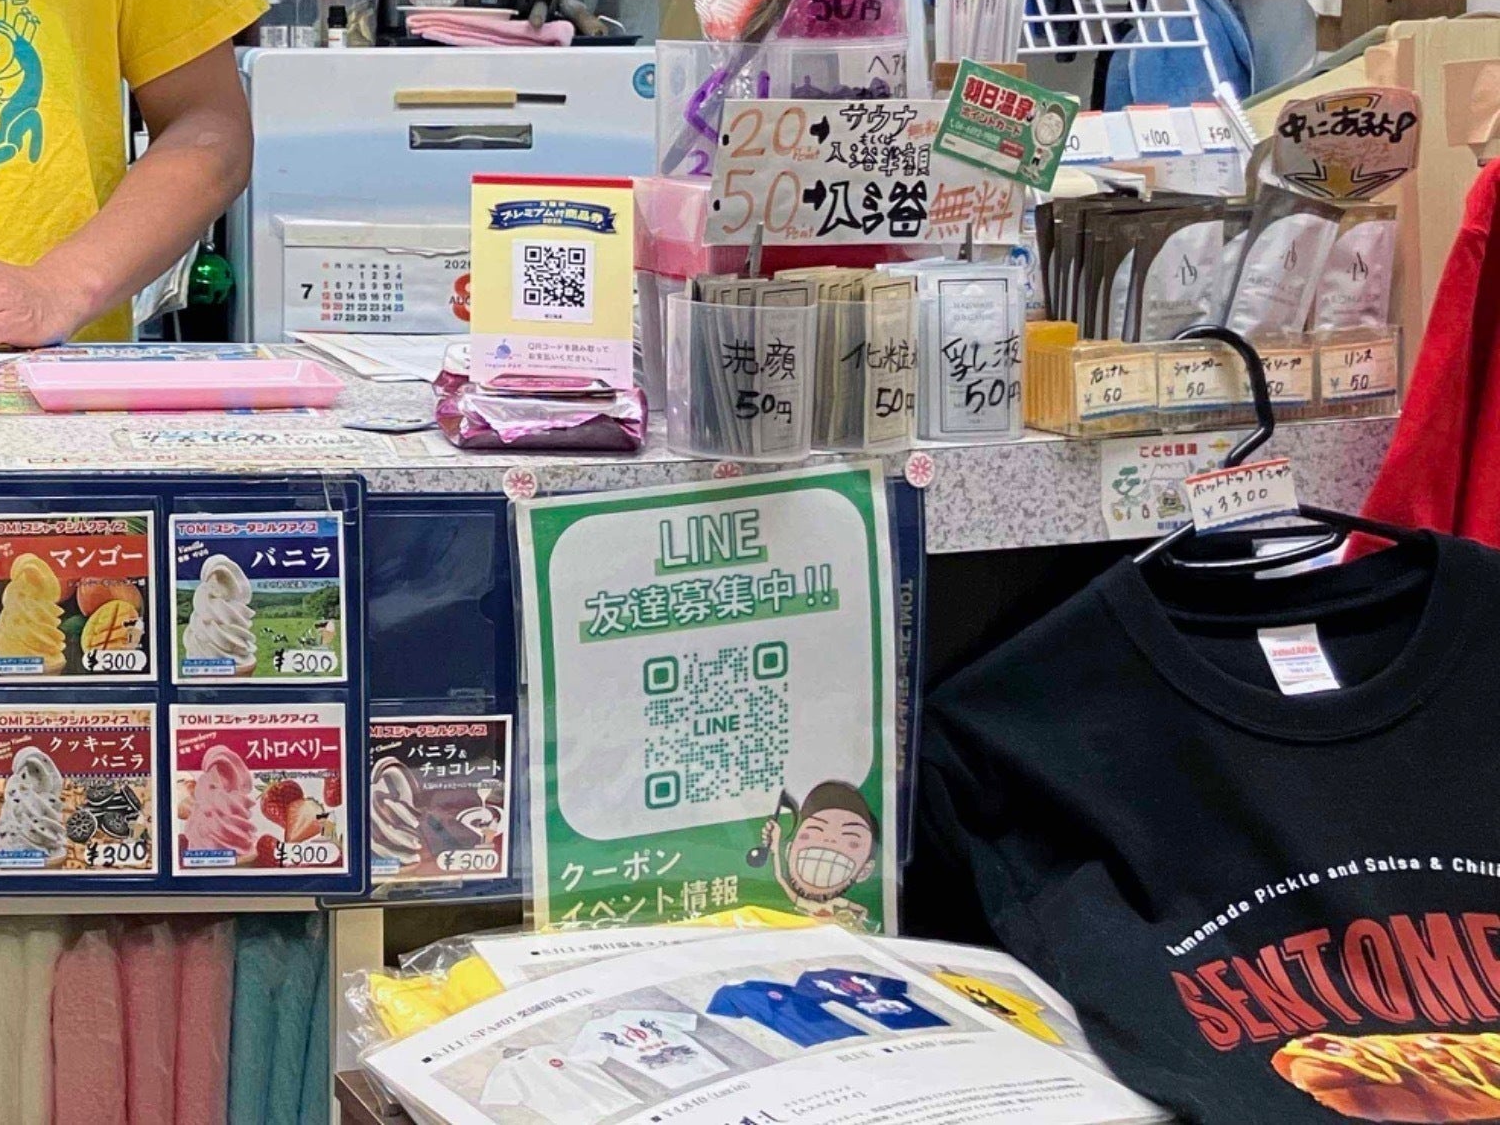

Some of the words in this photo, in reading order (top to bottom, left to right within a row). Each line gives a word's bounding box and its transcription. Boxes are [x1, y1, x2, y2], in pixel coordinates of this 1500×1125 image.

[962, 75, 1037, 126] 朝日温泉
[729, 107, 808, 159] 20
[840, 104, 919, 138] サウナ
[721, 169, 802, 235] 50
[816, 179, 929, 238] 入浴
[924, 179, 1018, 241] 無料
[301, 284, 313, 300] 7
[721, 338, 797, 381] 洗顔
[840, 337, 919, 373] 化粧
[1343, 349, 1374, 368] リンス
[735, 390, 793, 425] 50円
[49, 543, 144, 568] マンゴー
[659, 509, 761, 568] LINE
[250, 546, 332, 571] バニラ
[585, 564, 832, 636] 友達募集中!!
[693, 714, 741, 737] LINE
[49, 734, 136, 754] クッキーズ
[90, 753, 145, 770] バニラ
[245, 737, 339, 763] ストロベリー
[407, 742, 467, 759] バニラ&
[418, 759, 502, 778] チョコレート
[560, 848, 683, 892] クーポン
[1253, 872, 1320, 905] Pickle
[1326, 860, 1360, 880] and
[1363, 856, 1421, 872] Salsa
[1429, 856, 1443, 871] &
[560, 874, 740, 930] イベント情報
